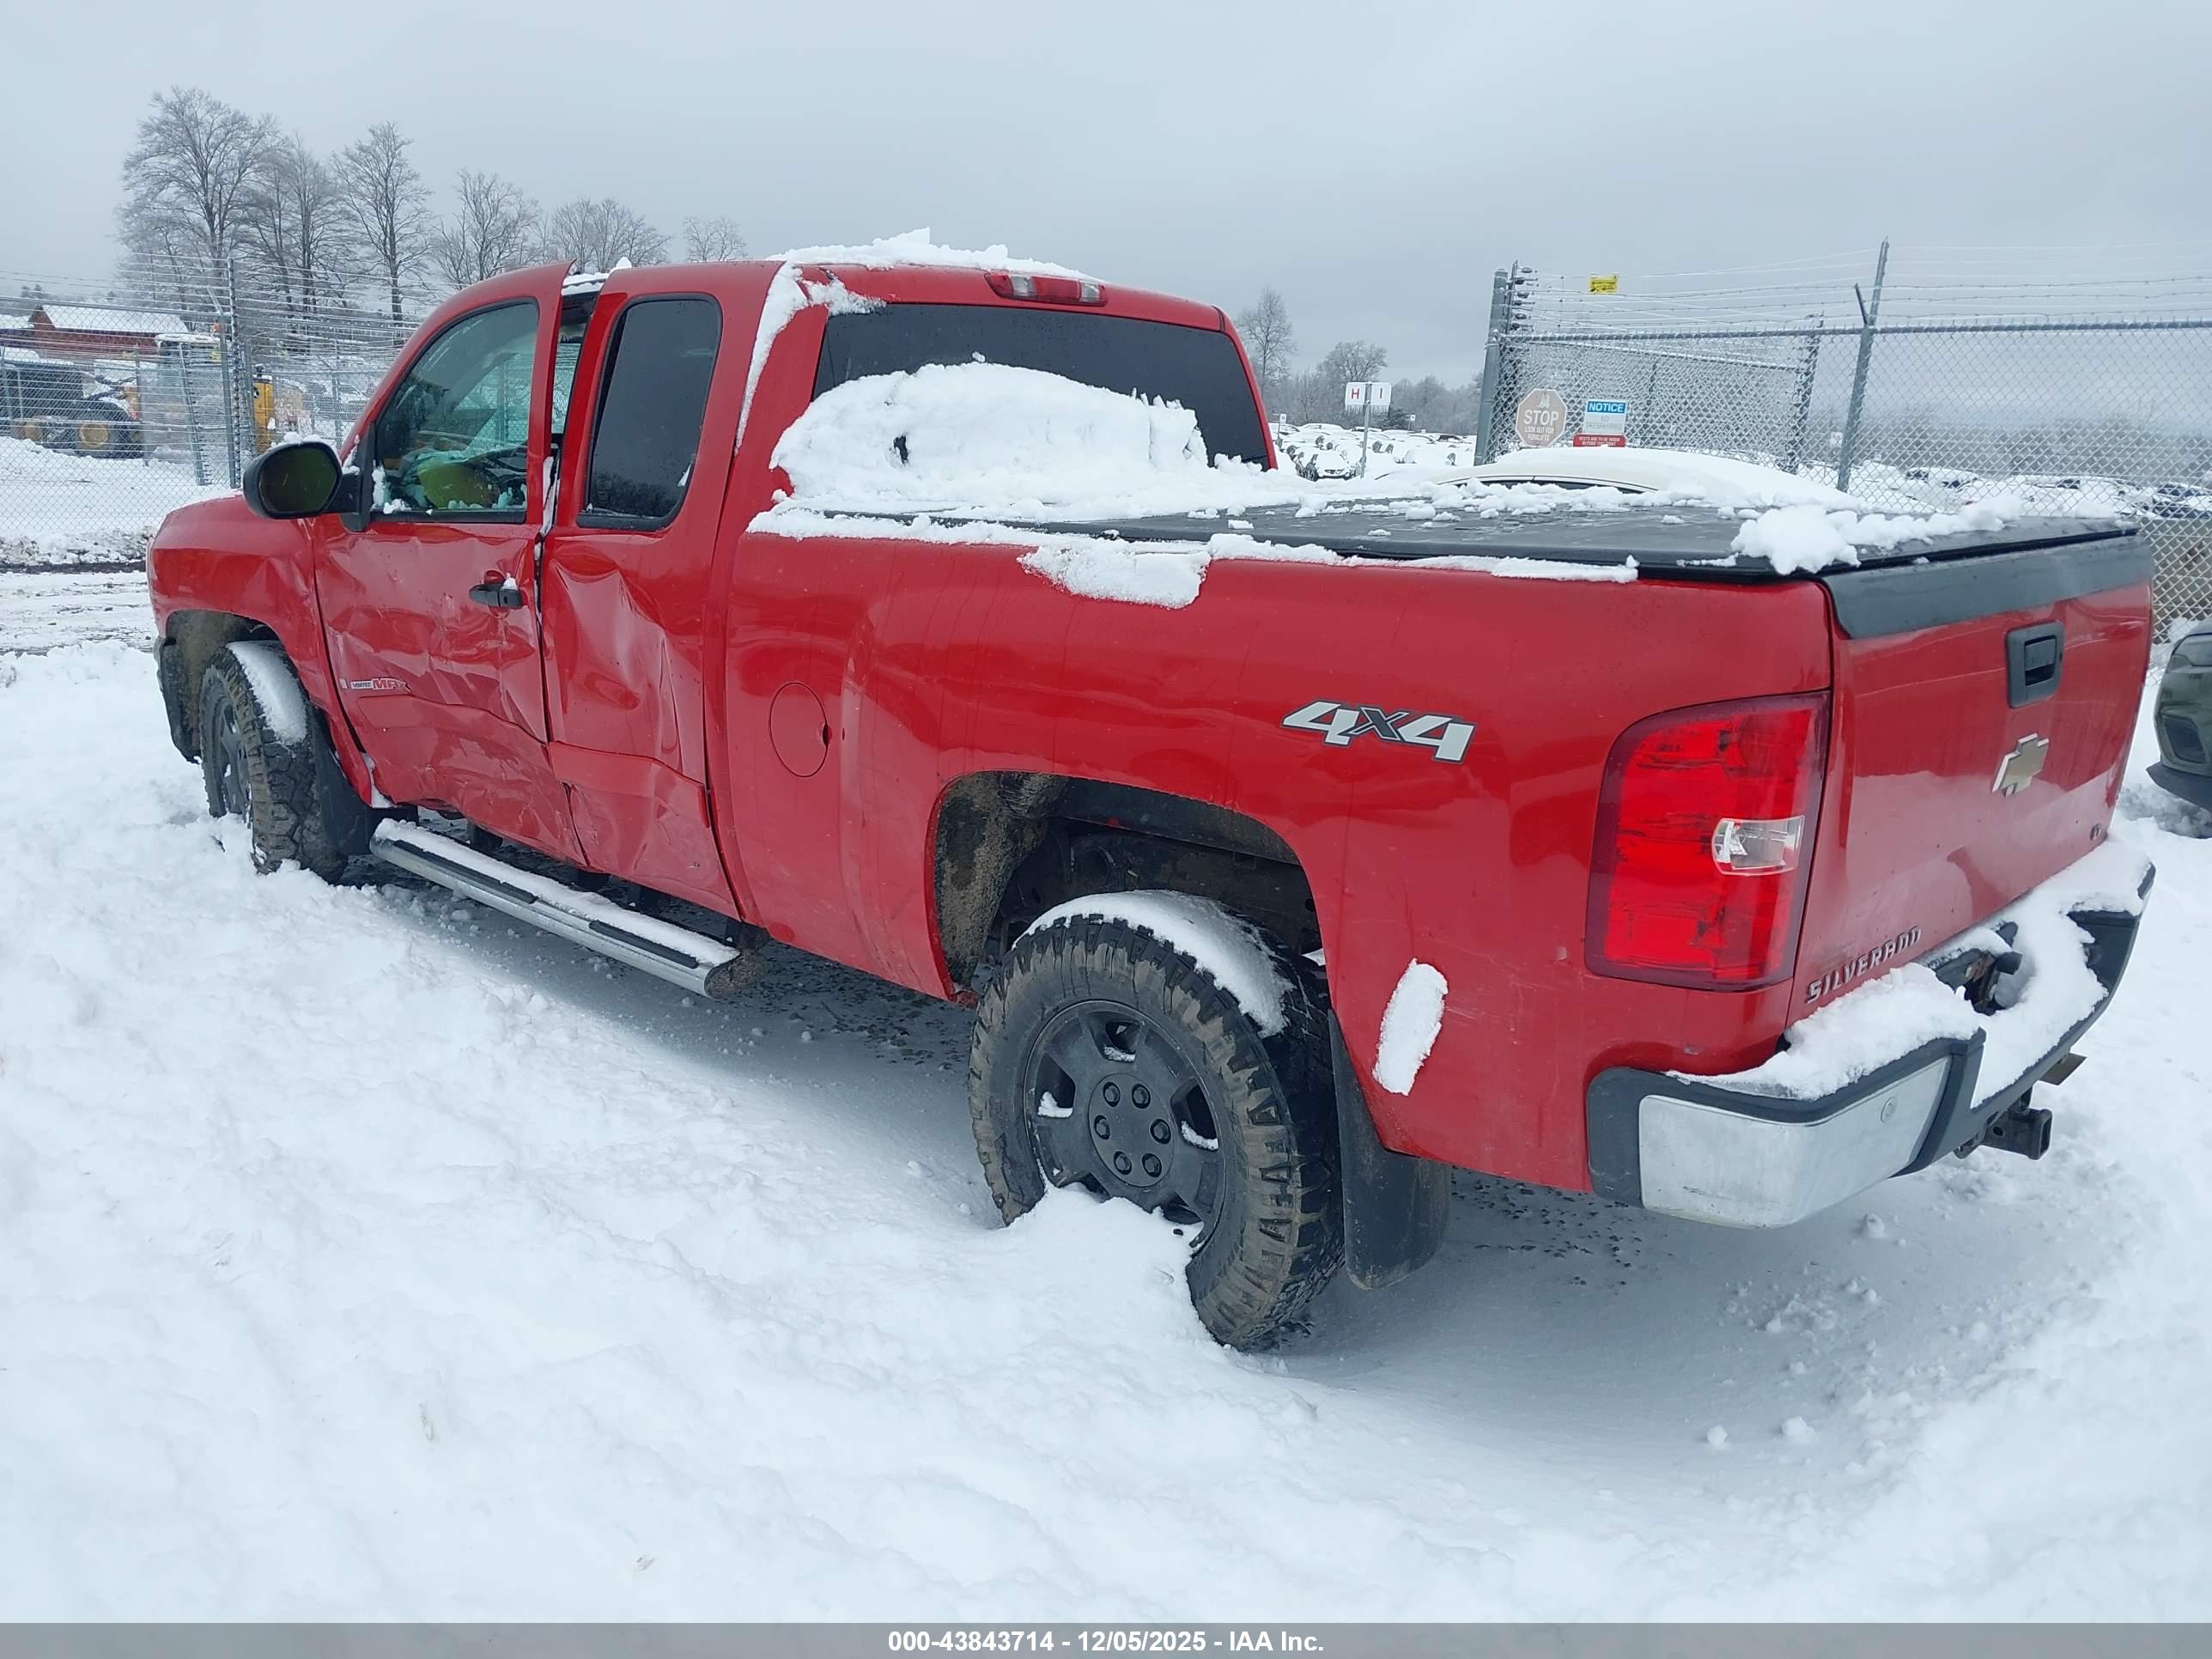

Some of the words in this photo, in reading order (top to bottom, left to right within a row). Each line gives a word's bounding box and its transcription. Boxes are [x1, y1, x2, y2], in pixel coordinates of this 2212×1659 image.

[1351, 387, 1360, 399] H
[1589, 402, 1625, 412] NOTICE
[1523, 409, 1559, 426] STOP
[1806, 926, 1922, 1004] SILVERADO
